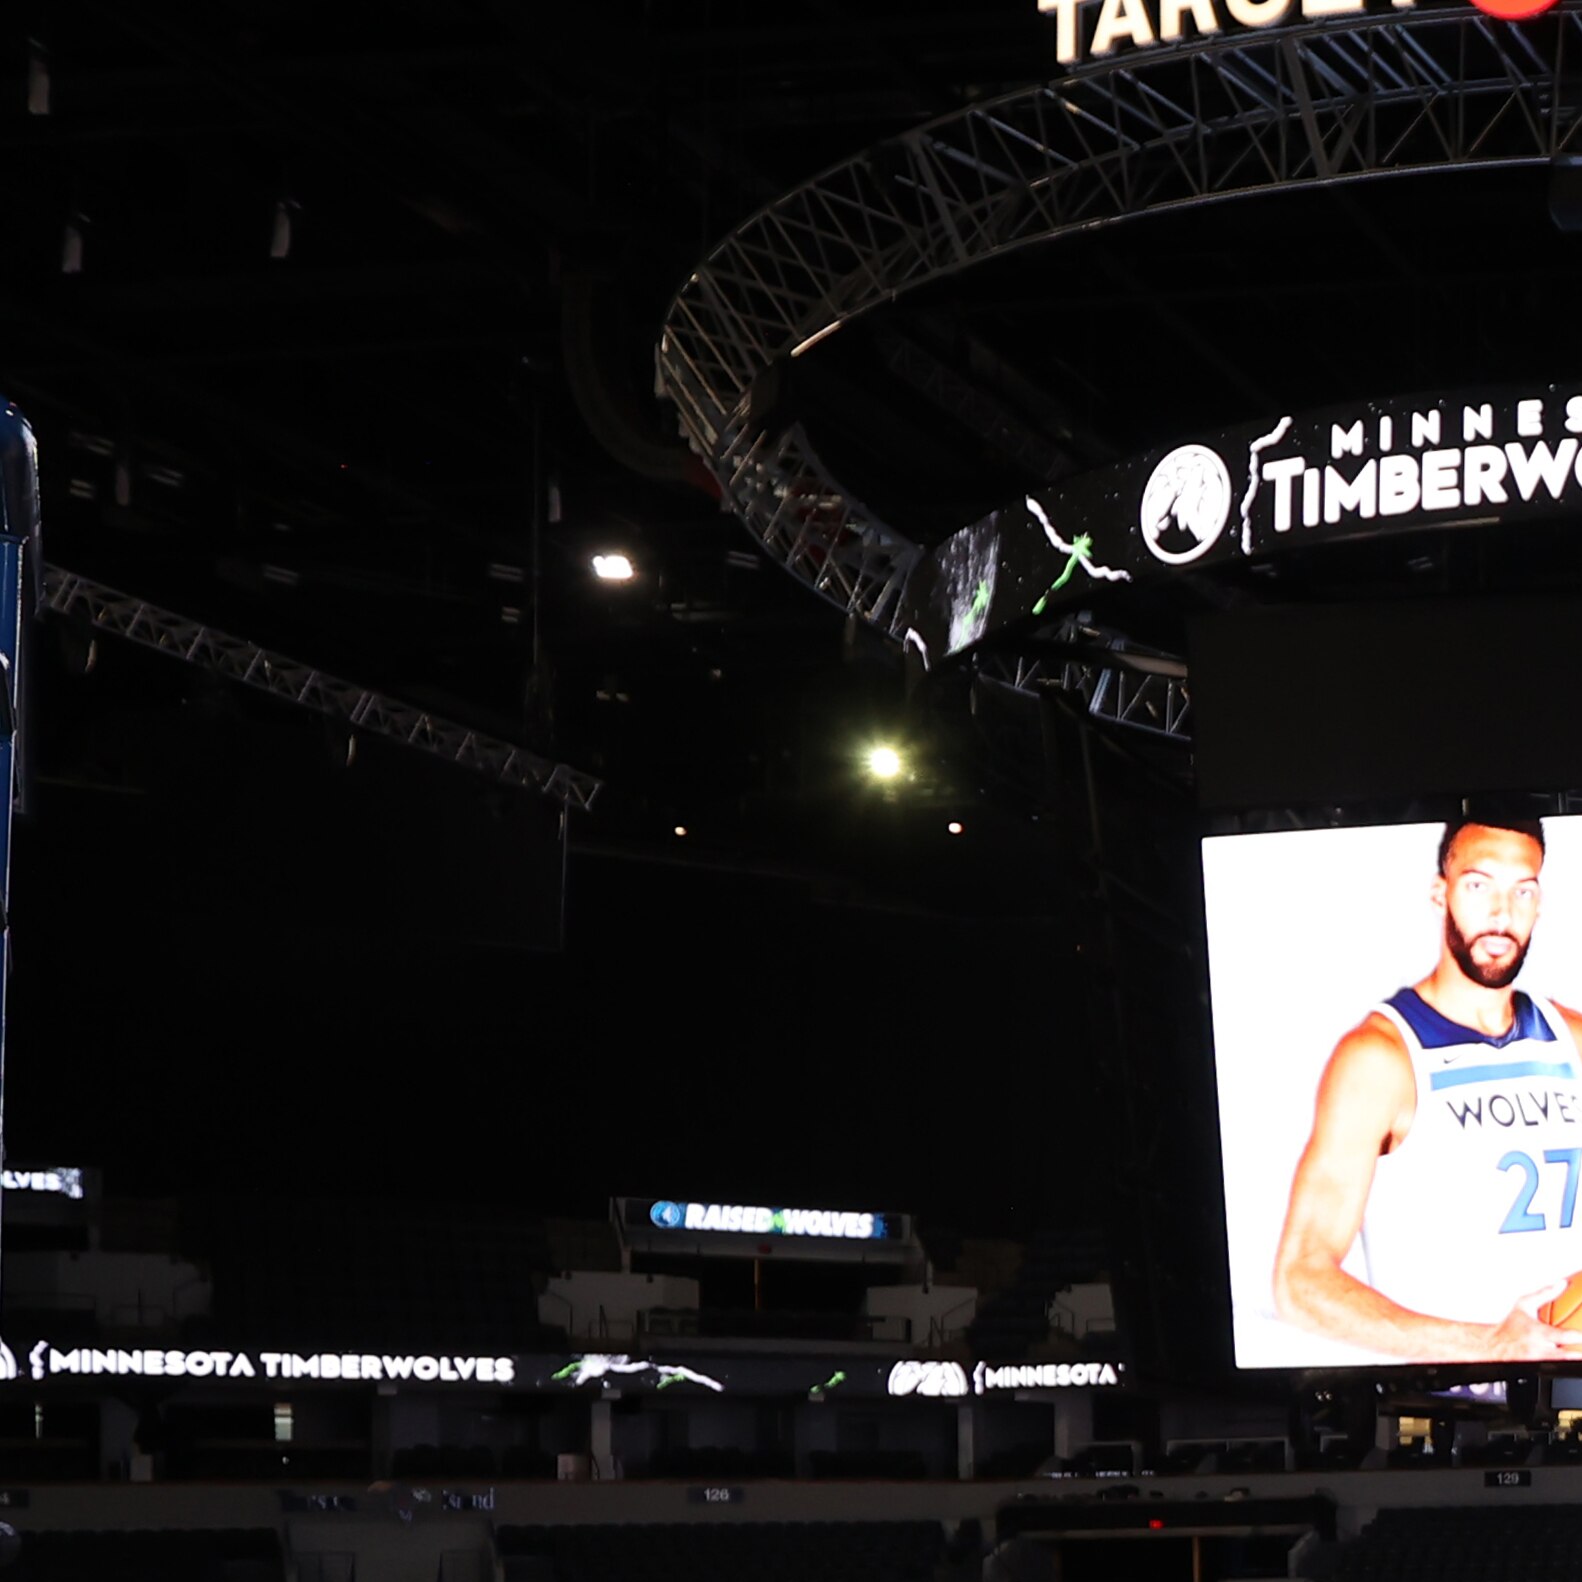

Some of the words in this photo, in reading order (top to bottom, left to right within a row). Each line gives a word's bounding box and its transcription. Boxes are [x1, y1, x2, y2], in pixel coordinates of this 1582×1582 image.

[684, 1202, 775, 1232] RAISED
[781, 1208, 874, 1238] WOLVES
[49, 1348, 256, 1378] MINNESOTA
[259, 1351, 516, 1382] TIMBERWOLVES
[986, 1362, 1117, 1388] MINNESOTA
